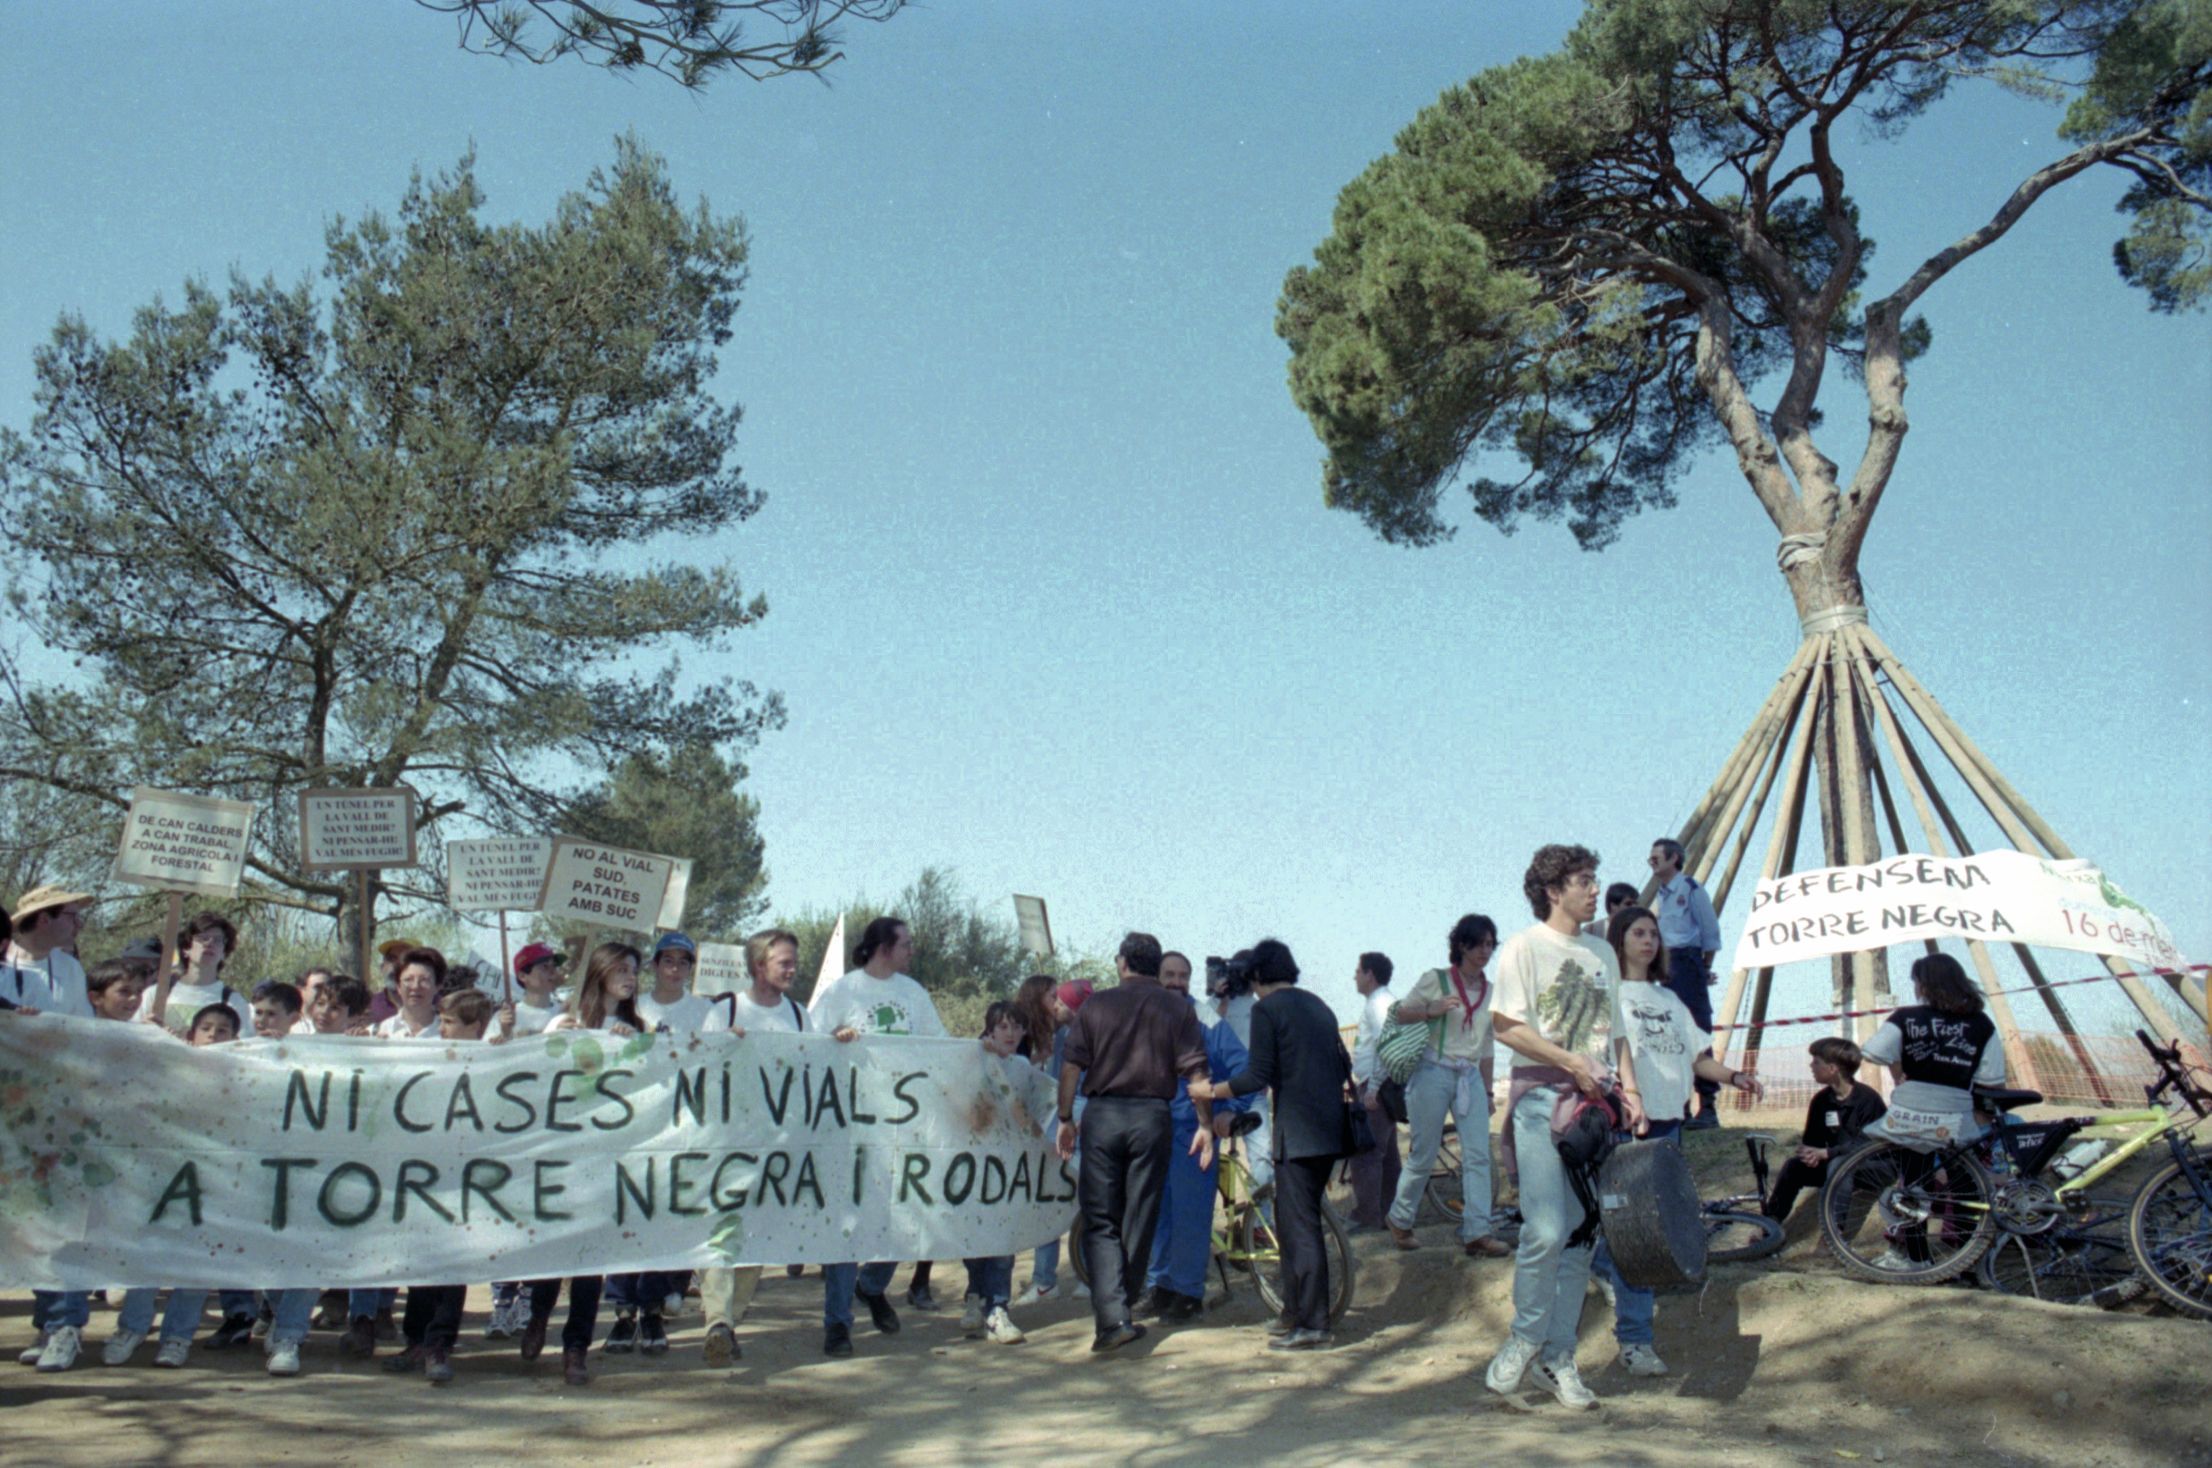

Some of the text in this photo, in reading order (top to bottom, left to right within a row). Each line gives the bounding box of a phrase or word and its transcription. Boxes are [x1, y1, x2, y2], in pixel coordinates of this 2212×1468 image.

[373, 800, 396, 809] PER
[342, 811, 371, 821] VALL
[374, 811, 388, 821] DE
[138, 814, 243, 838] DE CAN CALDERS
[322, 823, 397, 834] SANT MEDIR?
[142, 829, 150, 837] A
[154, 830, 180, 843] CAN
[132, 840, 167, 852] ZONA
[315, 848, 337, 858] VAL
[519, 842, 541, 852] PER
[151, 855, 215, 873] FORESTAL
[487, 855, 517, 865] VALL
[520, 854, 534, 864] DE
[573, 847, 654, 873] NO AL VIAL
[466, 868, 496, 879] SANT
[572, 879, 641, 904] PATATES
[1751, 858, 1991, 913] DEFENSEM
[458, 893, 479, 903] VAL
[568, 896, 637, 919] AMB SUC
[1748, 903, 2015, 949] TORRE NEGRA
[2061, 909, 2100, 938] 16
[2107, 921, 2138, 948] de
[699, 967, 740, 979] DIGUES
[1905, 1018, 1970, 1039] The First
[282, 1060, 929, 1134] NI CASES NI VIALS
[1893, 1110, 1940, 1125] GRAIN
[148, 1160, 203, 1226] A
[260, 1157, 576, 1231] TORRE
[615, 1150, 826, 1226] NEGRA
[900, 1150, 1079, 1206] RODALS
